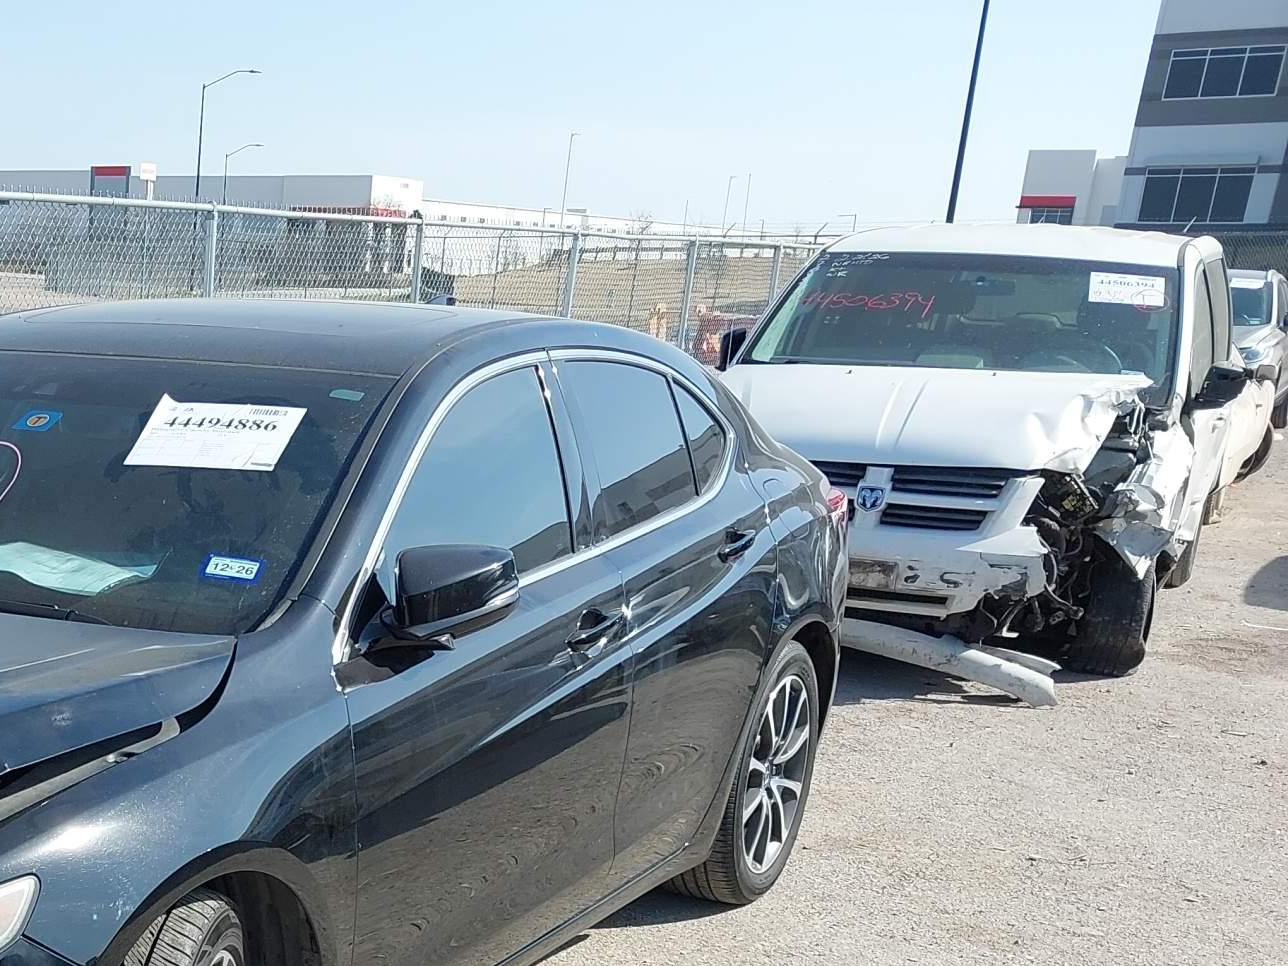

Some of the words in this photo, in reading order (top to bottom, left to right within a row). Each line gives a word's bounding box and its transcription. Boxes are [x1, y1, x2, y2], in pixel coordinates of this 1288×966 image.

[163, 416, 281, 432] 44494886
[213, 562, 230, 572] 12
[235, 565, 254, 576] 26
